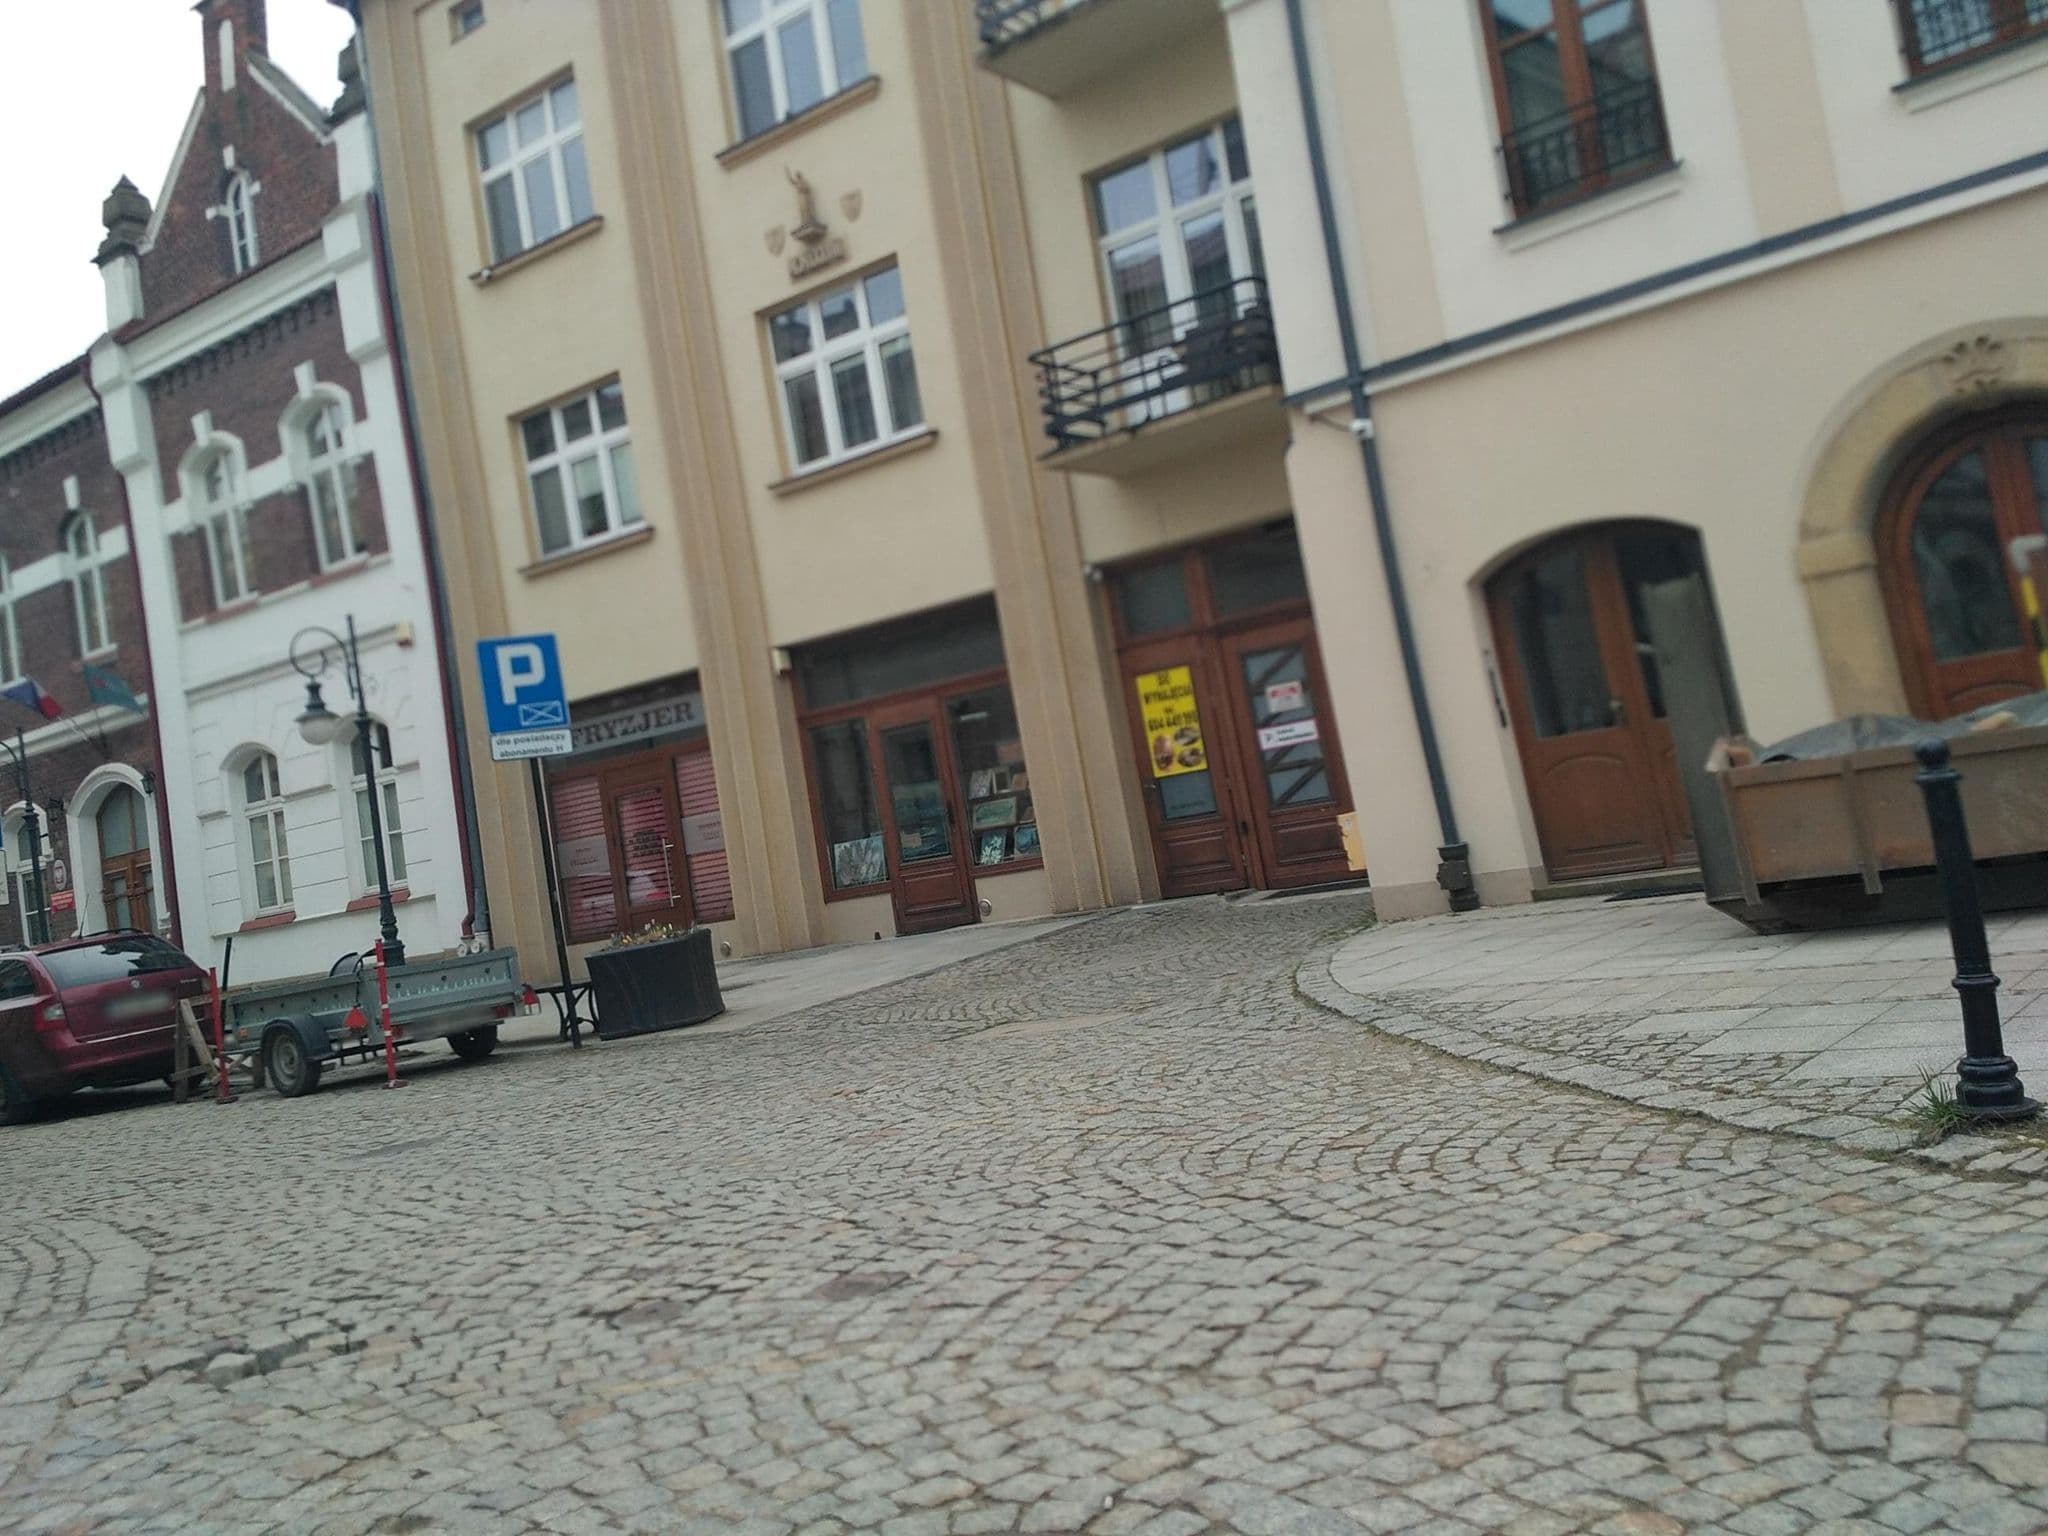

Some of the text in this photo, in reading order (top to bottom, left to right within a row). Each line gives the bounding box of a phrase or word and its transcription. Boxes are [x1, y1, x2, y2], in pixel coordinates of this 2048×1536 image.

[496, 643, 546, 705] P
[572, 702, 694, 746] FRYZJER
[500, 746, 553, 758] abonamentu
